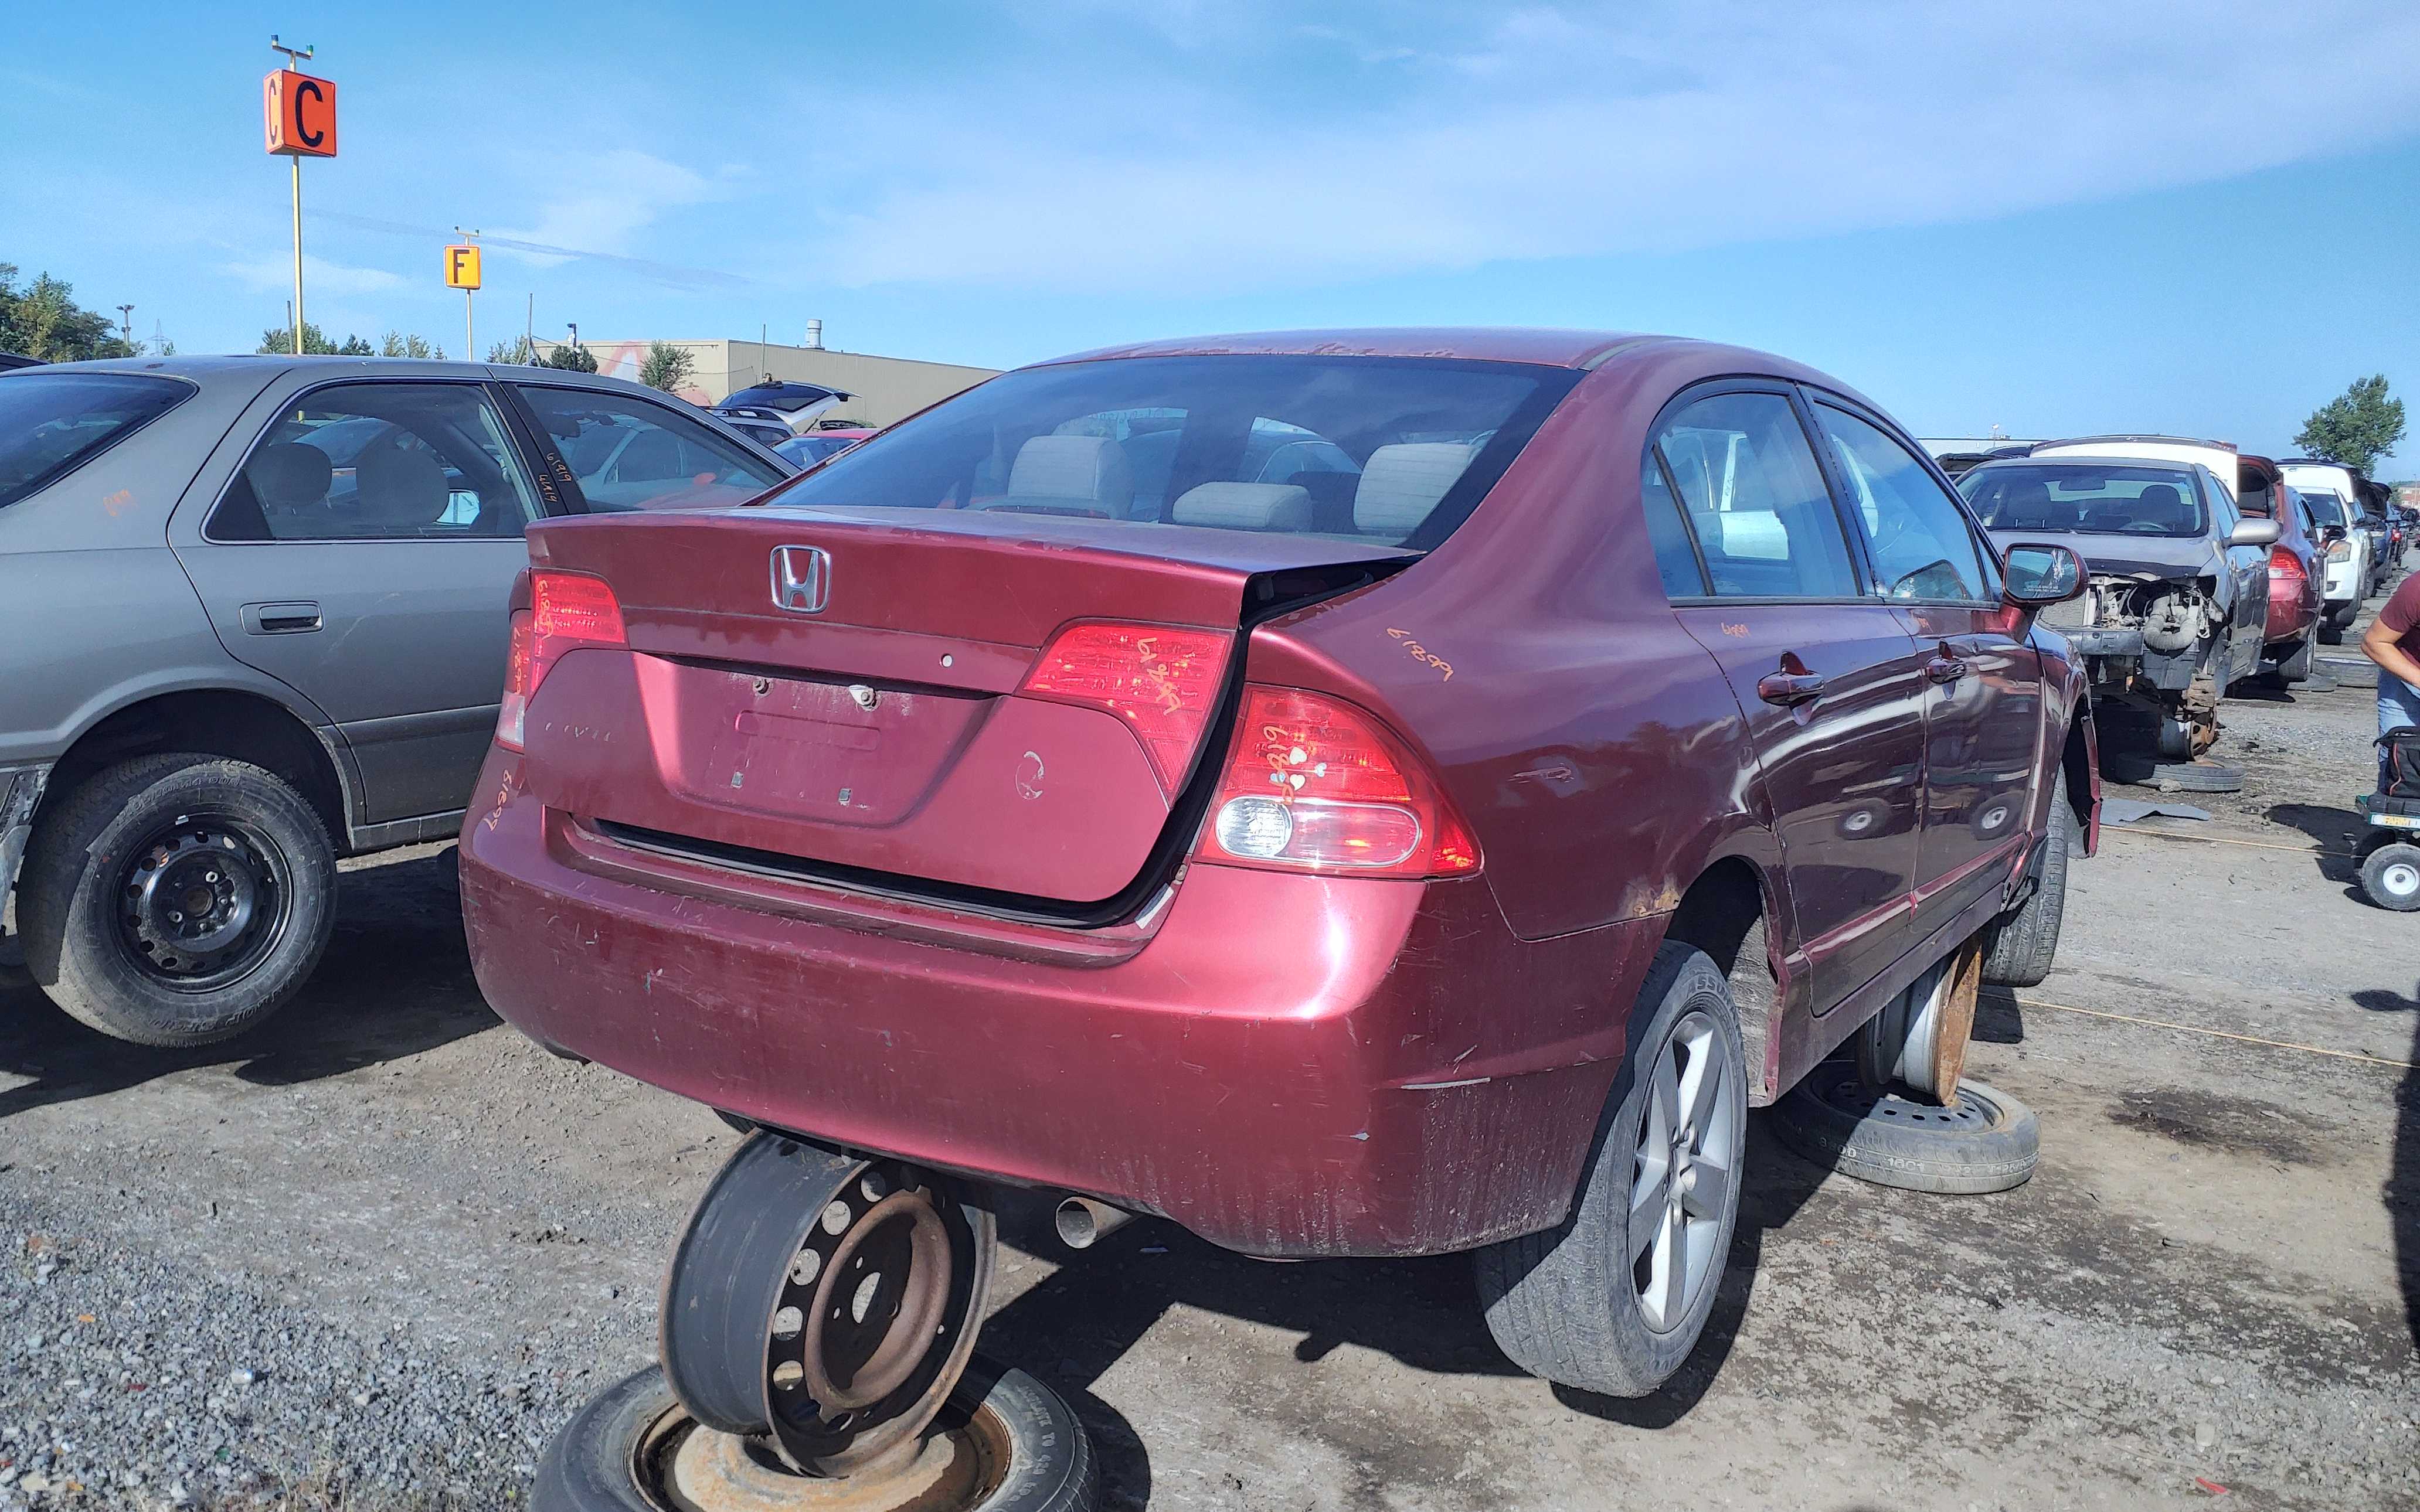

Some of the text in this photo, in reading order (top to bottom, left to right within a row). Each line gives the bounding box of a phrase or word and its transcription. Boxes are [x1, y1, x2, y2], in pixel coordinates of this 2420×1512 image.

[268, 79, 277, 145] C
[295, 81, 324, 147] C
[453, 250, 470, 284] F
[1386, 628, 1454, 682] 61899
